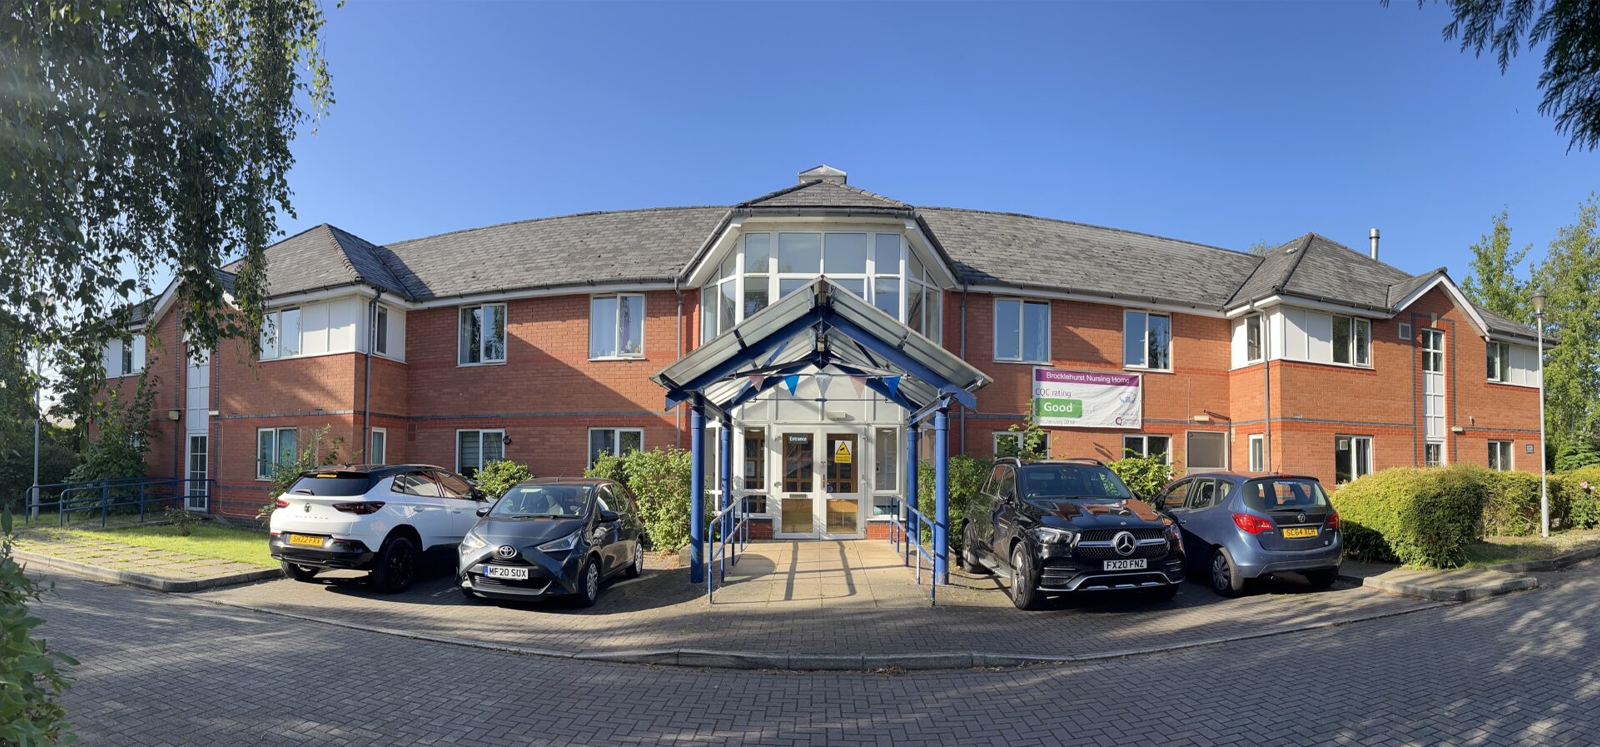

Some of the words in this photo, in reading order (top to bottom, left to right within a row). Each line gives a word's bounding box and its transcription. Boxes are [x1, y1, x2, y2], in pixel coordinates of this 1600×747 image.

[1046, 372, 1085, 381] Brocklehurst
[1086, 375, 1110, 383] Nursing
[1035, 388, 1050, 397] CQC
[1051, 389, 1072, 398] rating
[1043, 402, 1073, 412] Good
[1106, 560, 1127, 569] FX20
[1129, 560, 1144, 568] FNZ
[488, 566, 510, 577] MF20
[511, 568, 527, 578] SUX
